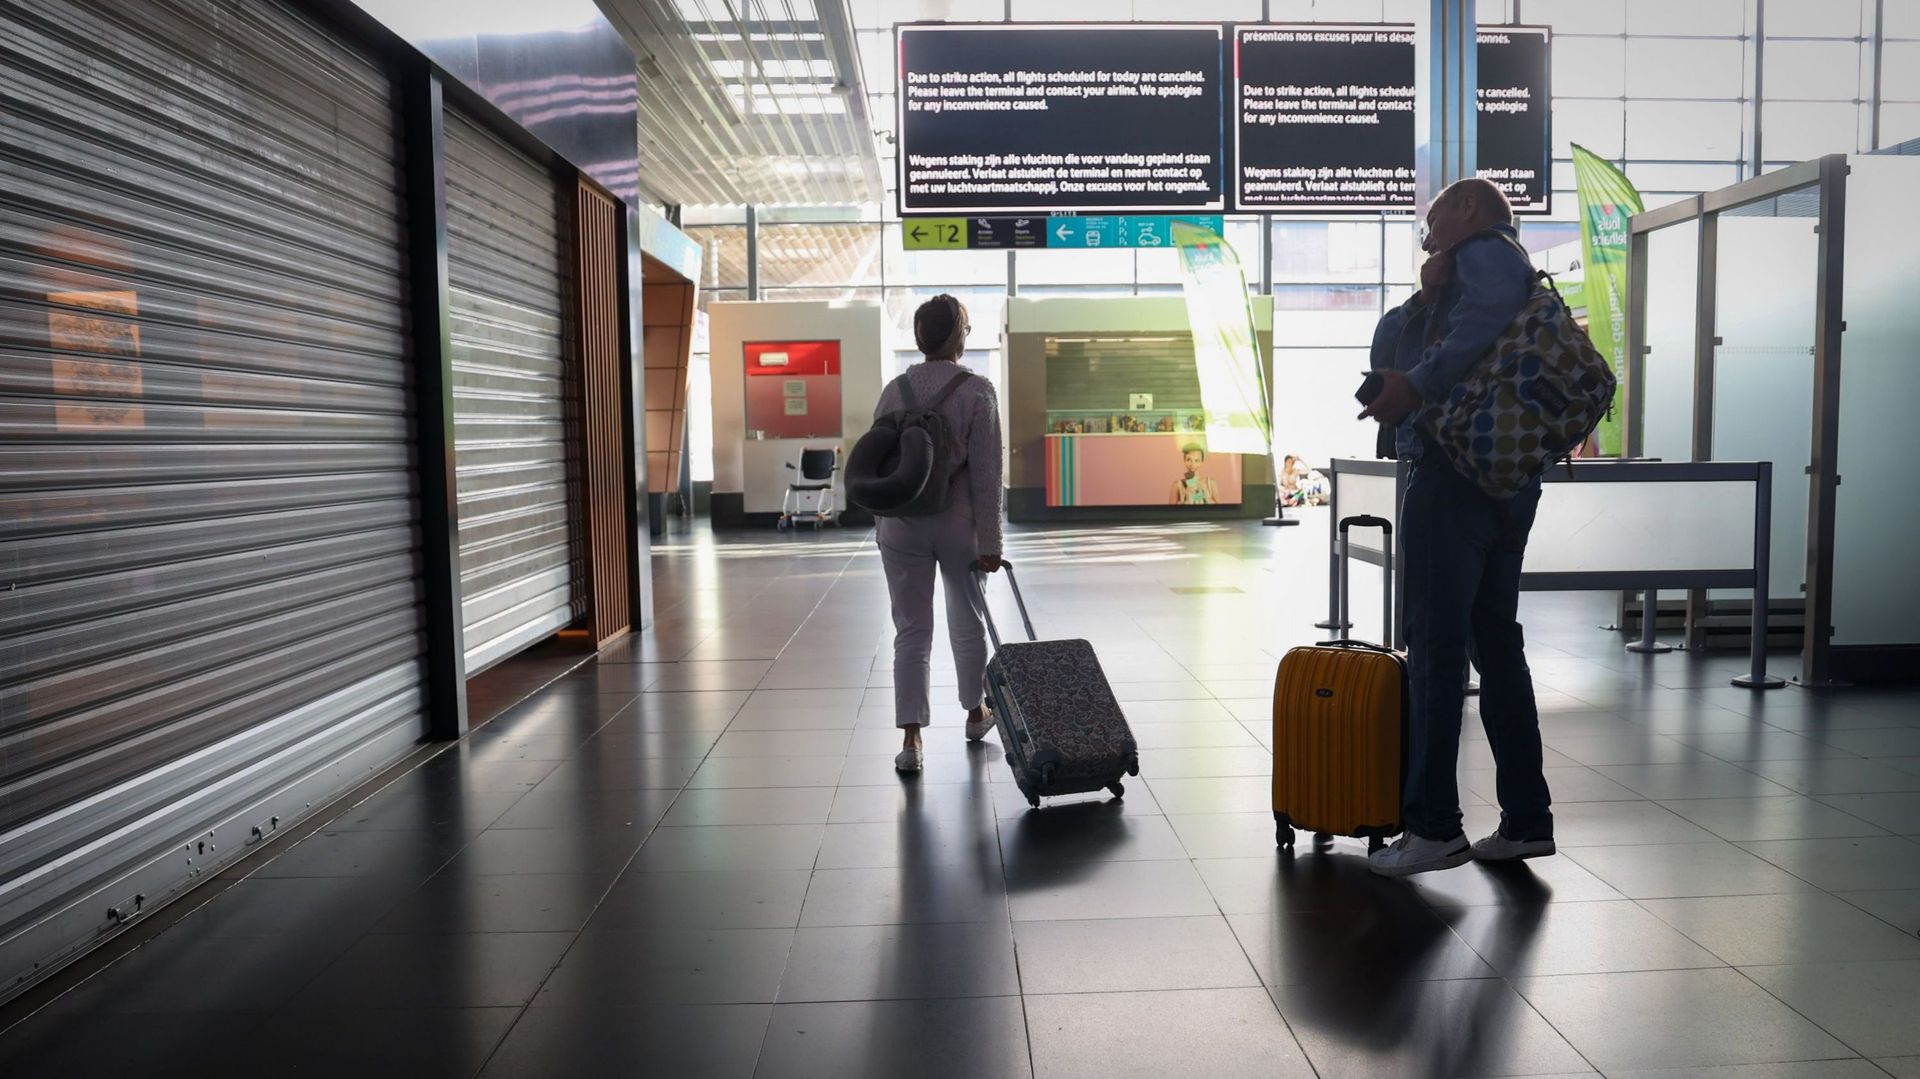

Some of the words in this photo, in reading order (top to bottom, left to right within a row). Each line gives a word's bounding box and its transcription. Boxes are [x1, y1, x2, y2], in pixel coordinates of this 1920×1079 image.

[1314, 34, 1350, 42] excuses
[1351, 34, 1373, 44] pour
[1374, 33, 1388, 42] les
[908, 72, 928, 83] Due
[929, 72, 940, 83] to
[941, 72, 968, 83] strike
[969, 72, 1002, 84] action,
[1003, 71, 1015, 82] all
[1016, 71, 1046, 84] flights
[1048, 71, 1095, 82] scheduled
[1097, 71, 1111, 82] for
[1112, 71, 1140, 84] today
[1141, 73, 1157, 82] are
[1158, 71, 1205, 82] cancelled.
[908, 86, 939, 96] Please
[940, 86, 966, 96] leave
[967, 86, 983, 96] the
[984, 86, 1025, 96] terminal
[1026, 85, 1044, 96] and
[1046, 85, 1082, 96] contact
[1083, 87, 1105, 98] your
[1107, 85, 1138, 95] airline.
[1140, 85, 1156, 95] We
[1157, 85, 1202, 97] apologise
[1244, 85, 1263, 96] Due
[1264, 85, 1275, 96] to
[1276, 85, 1302, 96] strike
[1303, 86, 1335, 97] action,
[1336, 86, 1347, 96] all
[1349, 86, 1378, 99] flights
[1379, 87, 1415, 97] schedul
[1485, 87, 1531, 98] cancelled.
[908, 99, 922, 110] for
[923, 101, 942, 112] any
[943, 99, 1011, 110] inconvenience
[1013, 99, 1048, 109] caused.
[1244, 99, 1273, 109] Please
[1275, 99, 1300, 109] leave
[1301, 99, 1317, 110] the
[1318, 99, 1356, 110] terminal
[1358, 100, 1376, 110] and
[1377, 100, 1412, 110] contact
[1485, 101, 1528, 114] apologise
[1244, 113, 1257, 123] for
[1259, 115, 1276, 125] any
[1278, 113, 1344, 123] inconvenience
[1345, 113, 1380, 123] caused.
[909, 155, 948, 168] Wegens
[949, 155, 983, 168] staking
[984, 155, 1002, 168] zijn
[1003, 155, 1021, 166] alle
[1022, 154, 1063, 165] vluchten
[1065, 154, 1080, 165] die
[1081, 156, 1103, 165] voor
[1104, 154, 1145, 167] vandaag
[1146, 154, 1183, 167] gepland
[1185, 154, 1210, 165] staan
[910, 169, 971, 182] geannuleerd.
[972, 169, 1006, 180] Verlaat
[1008, 169, 1055, 180] alstublieft
[1056, 168, 1069, 179] de
[1070, 168, 1109, 179] terminal
[1111, 170, 1123, 179] en
[1125, 170, 1151, 179] neem
[1152, 168, 1188, 179] contact
[1189, 170, 1203, 181] op
[1244, 167, 1281, 179] Wegens
[1282, 167, 1316, 179] staking
[1317, 167, 1333, 179] zijn
[1334, 167, 1352, 177] alle
[1353, 167, 1394, 177] vluchten
[1395, 167, 1410, 177] die
[1510, 168, 1535, 178] staan
[910, 182, 929, 193] met
[930, 184, 946, 193] uw
[947, 182, 1058, 195] luchtvaartmaatschappij.
[1060, 182, 1084, 193] Onze
[1086, 184, 1122, 192] excuses
[1123, 184, 1146, 192] voor
[1147, 182, 1163, 192] het
[1164, 182, 1210, 194] ongemak.
[1244, 181, 1304, 193] geannuleerd.
[1305, 181, 1338, 191] Verlaat
[1340, 181, 1385, 191] alstublieft
[1386, 181, 1398, 191] de
[1514, 183, 1527, 194] op
[935, 225, 960, 242] T2
